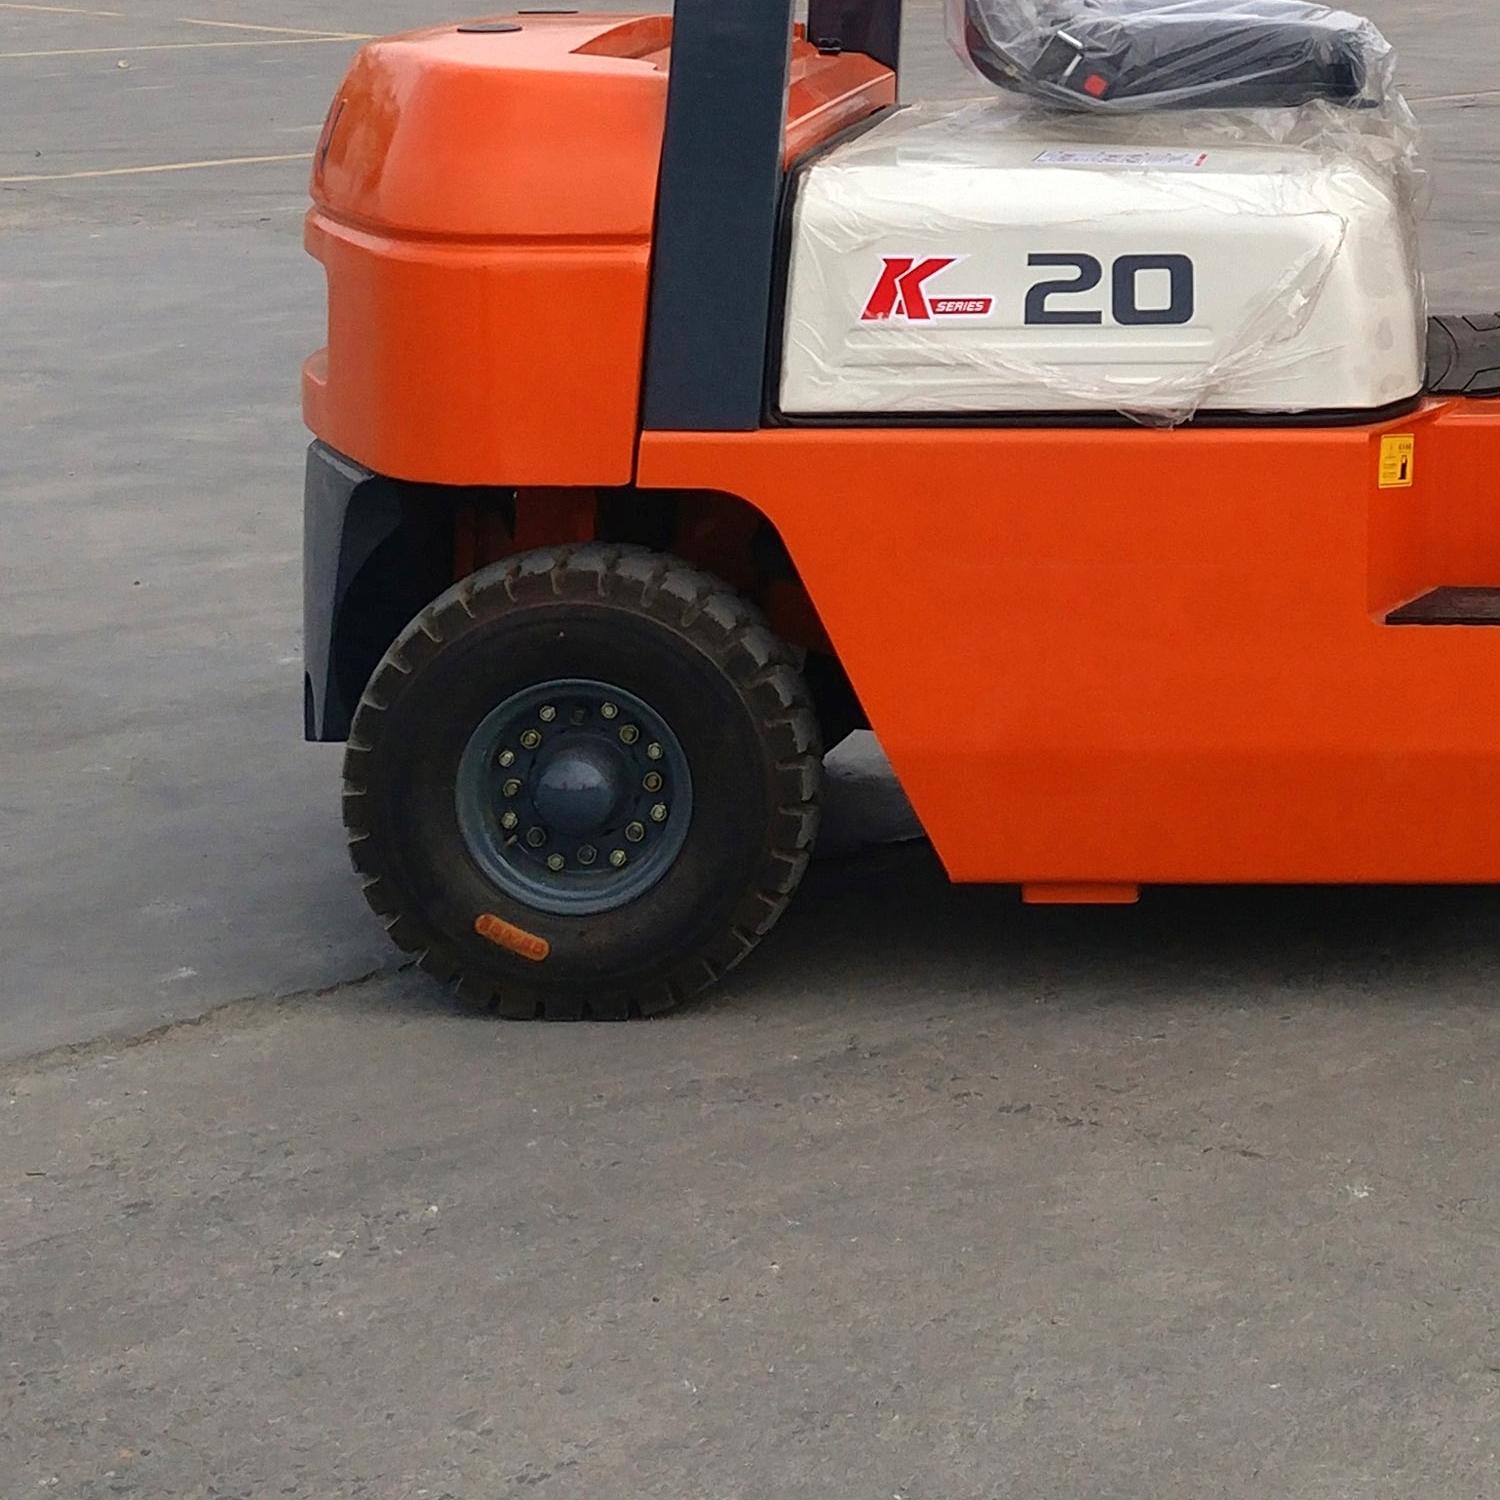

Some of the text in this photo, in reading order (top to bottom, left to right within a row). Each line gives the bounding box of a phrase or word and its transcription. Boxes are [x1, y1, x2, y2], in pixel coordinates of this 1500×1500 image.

[860, 258, 986, 320] K SERIES
[1023, 252, 1195, 326] 20
